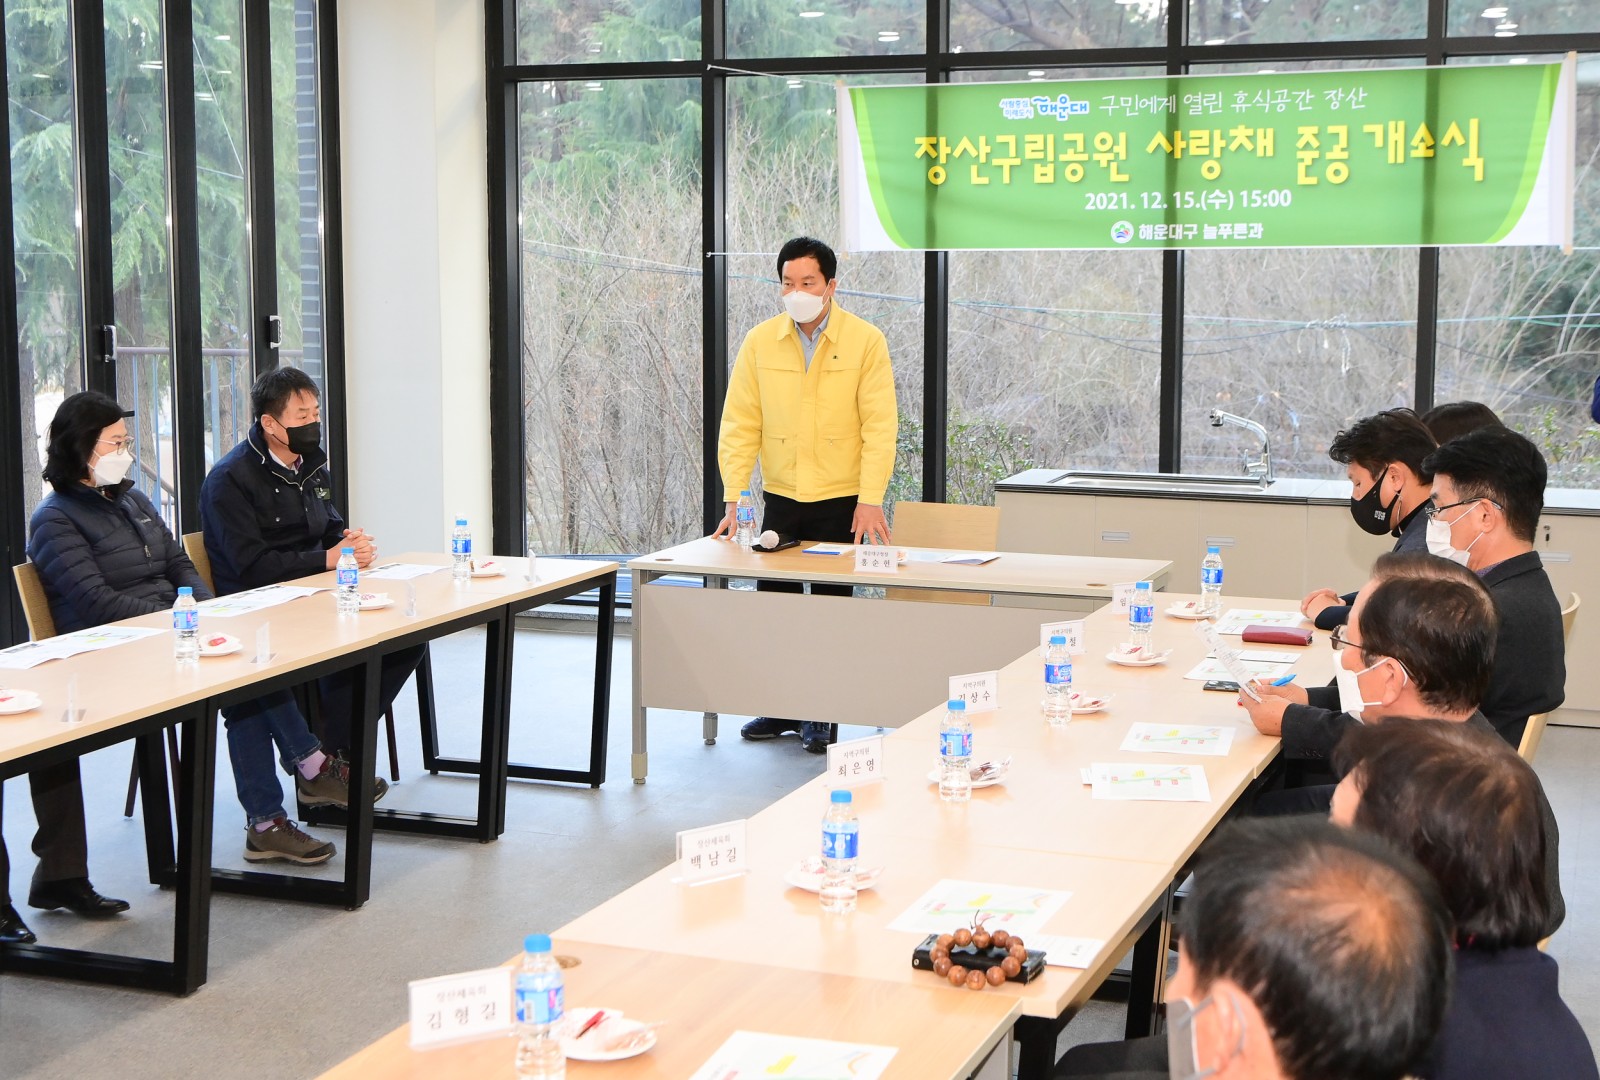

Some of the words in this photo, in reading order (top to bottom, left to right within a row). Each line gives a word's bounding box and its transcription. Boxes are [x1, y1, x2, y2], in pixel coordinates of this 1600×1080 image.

[1033, 95, 1088, 119] 해운대
[1099, 94, 1176, 117] 구민에게
[1183, 91, 1222, 115] 열린
[1230, 88, 1316, 113] 휴식공간
[1322, 86, 1369, 110] 장산
[914, 131, 1130, 186] 장산구립공원
[1145, 124, 1275, 181] 사랑채
[1295, 124, 1350, 186] 준공
[1362, 117, 1485, 182] 개소식
[1084, 191, 1136, 210] 2021.
[1140, 191, 1168, 210] 12.
[1172, 188, 1234, 211] 15.(수)
[1239, 188, 1293, 208] 15:00
[1138, 223, 1198, 241] 해운대구
[843, 746, 870, 759] 지역구의원
[838, 757, 875, 777] 최은영
